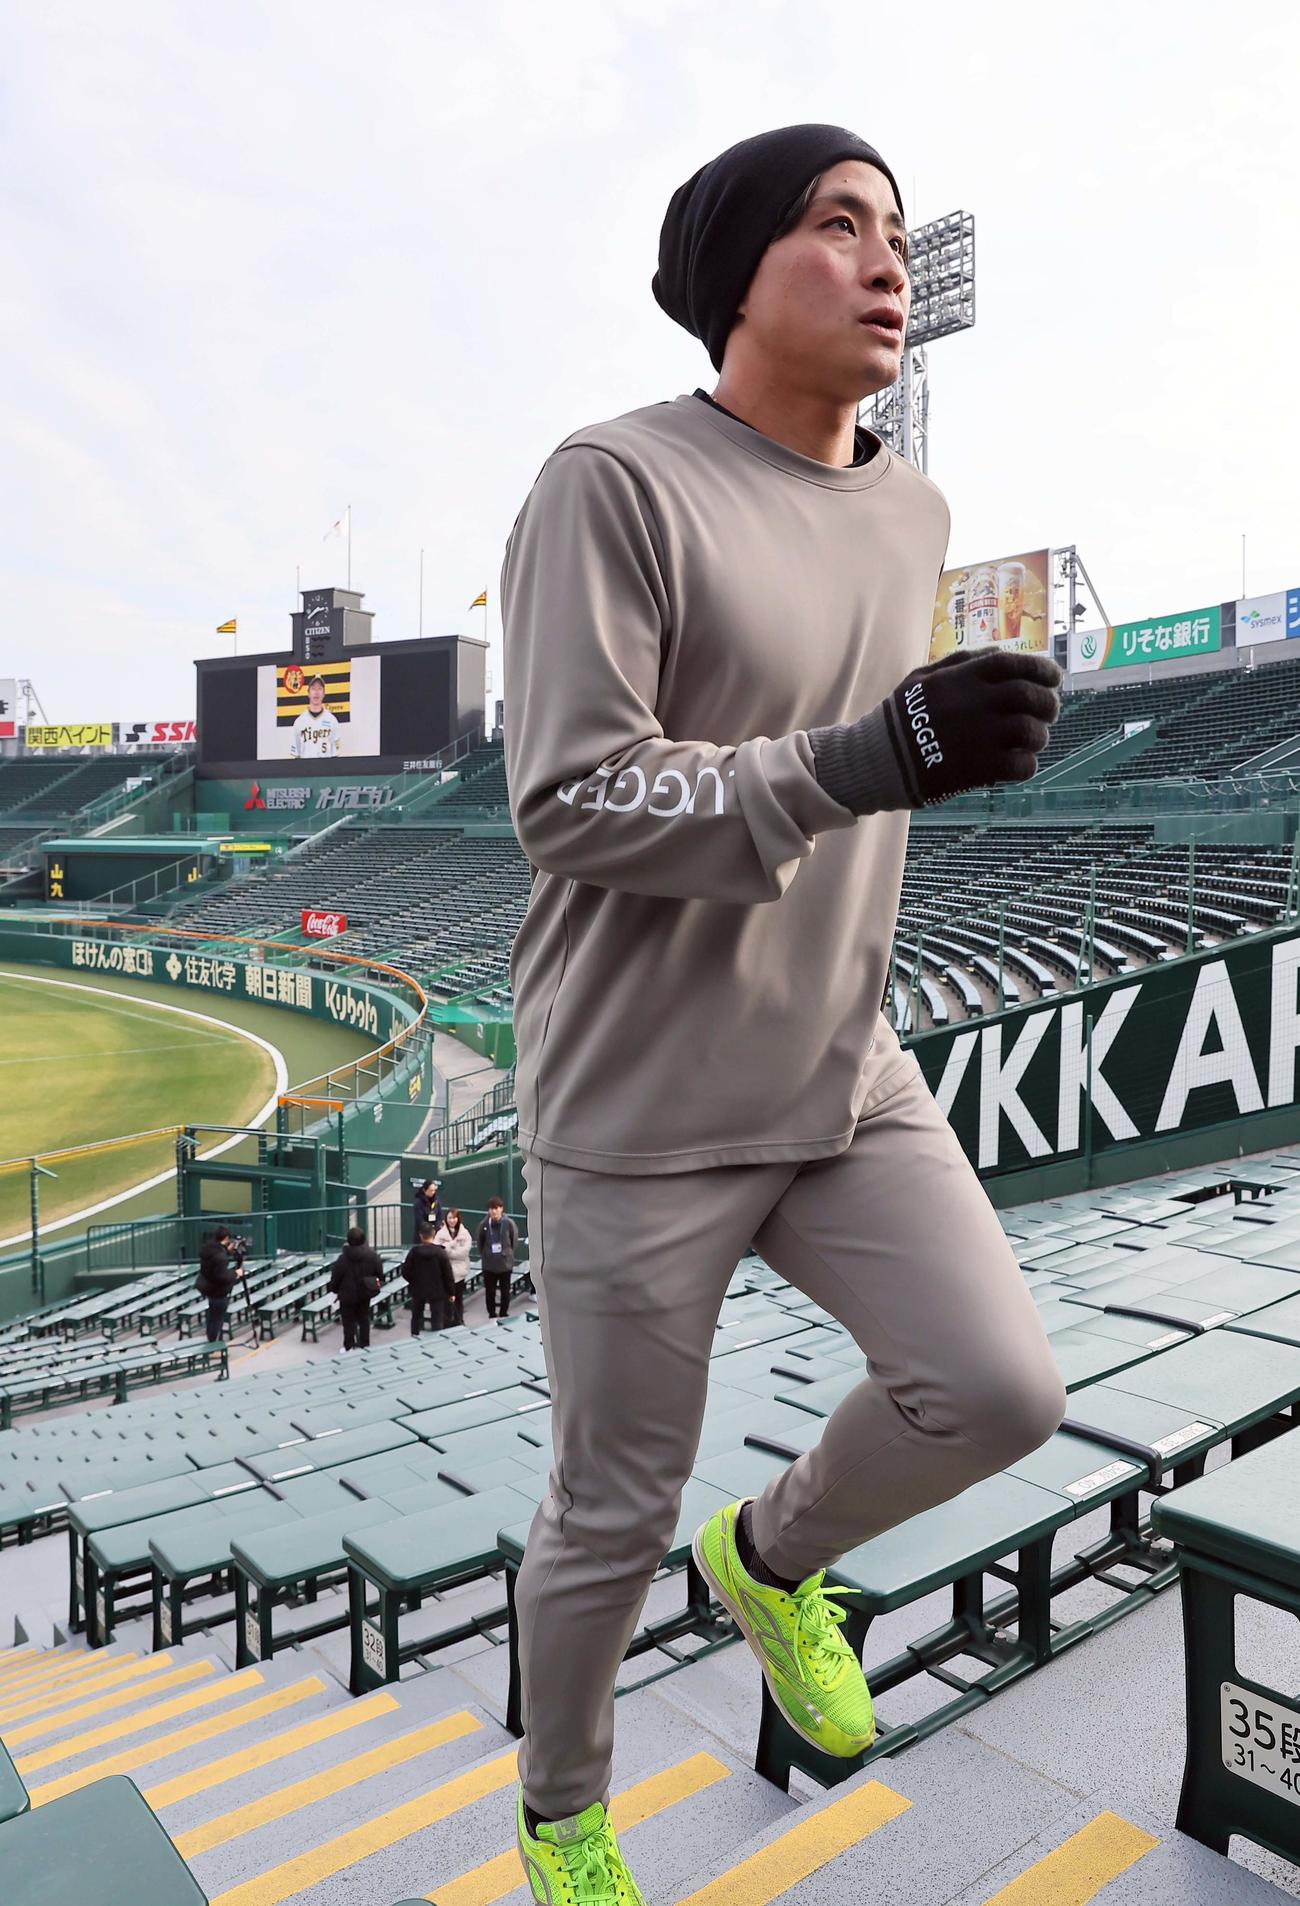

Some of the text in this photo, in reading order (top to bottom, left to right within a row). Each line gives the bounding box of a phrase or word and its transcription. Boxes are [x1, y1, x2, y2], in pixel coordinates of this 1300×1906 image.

[304, 625, 331, 636] CITIZEN
[1122, 617, 1211, 657] りそな銀行
[1250, 614, 1282, 630] sysmex
[28, 725, 111, 746] 関西ペイント
[904, 683, 944, 769] SLUGGER
[50, 863, 64, 898] 山九
[184, 955, 237, 991] 住友化学
[245, 964, 313, 1010] 朝日新聞
[325, 981, 378, 1036] Kubota
[363, 1627, 384, 1658] 32段
